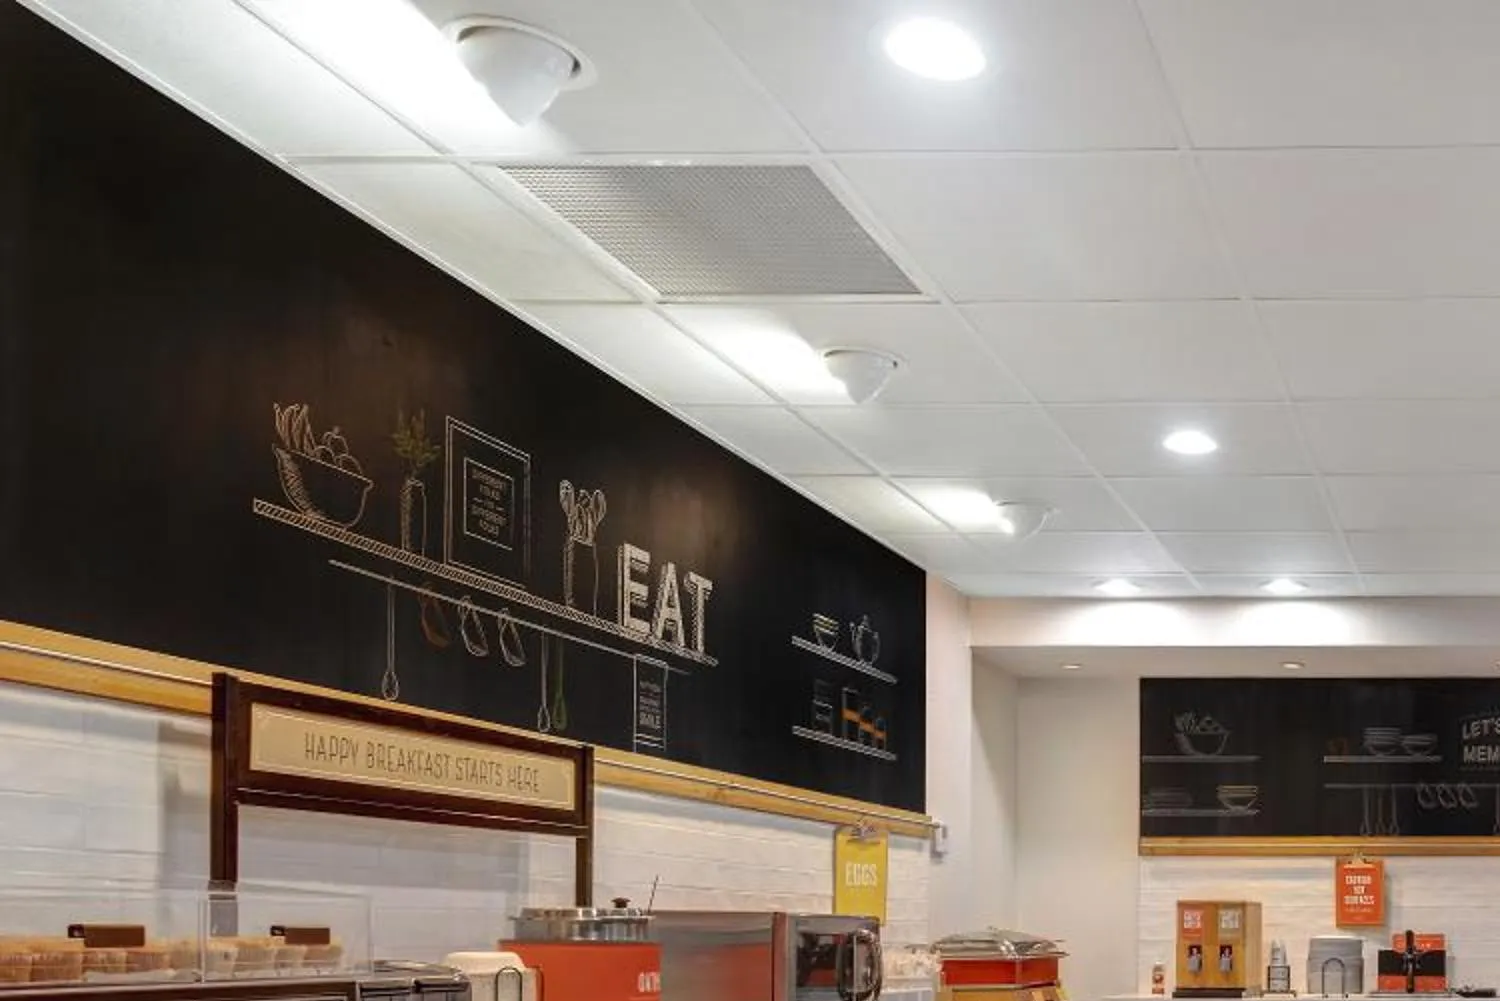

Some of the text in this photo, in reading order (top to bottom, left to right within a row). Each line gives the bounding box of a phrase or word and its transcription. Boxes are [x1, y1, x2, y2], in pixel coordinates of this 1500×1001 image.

[617, 541, 714, 653] EAT
[304, 732, 541, 793] HAPPY BREAKFAST STARTS HERE
[845, 861, 878, 888] EGGS
